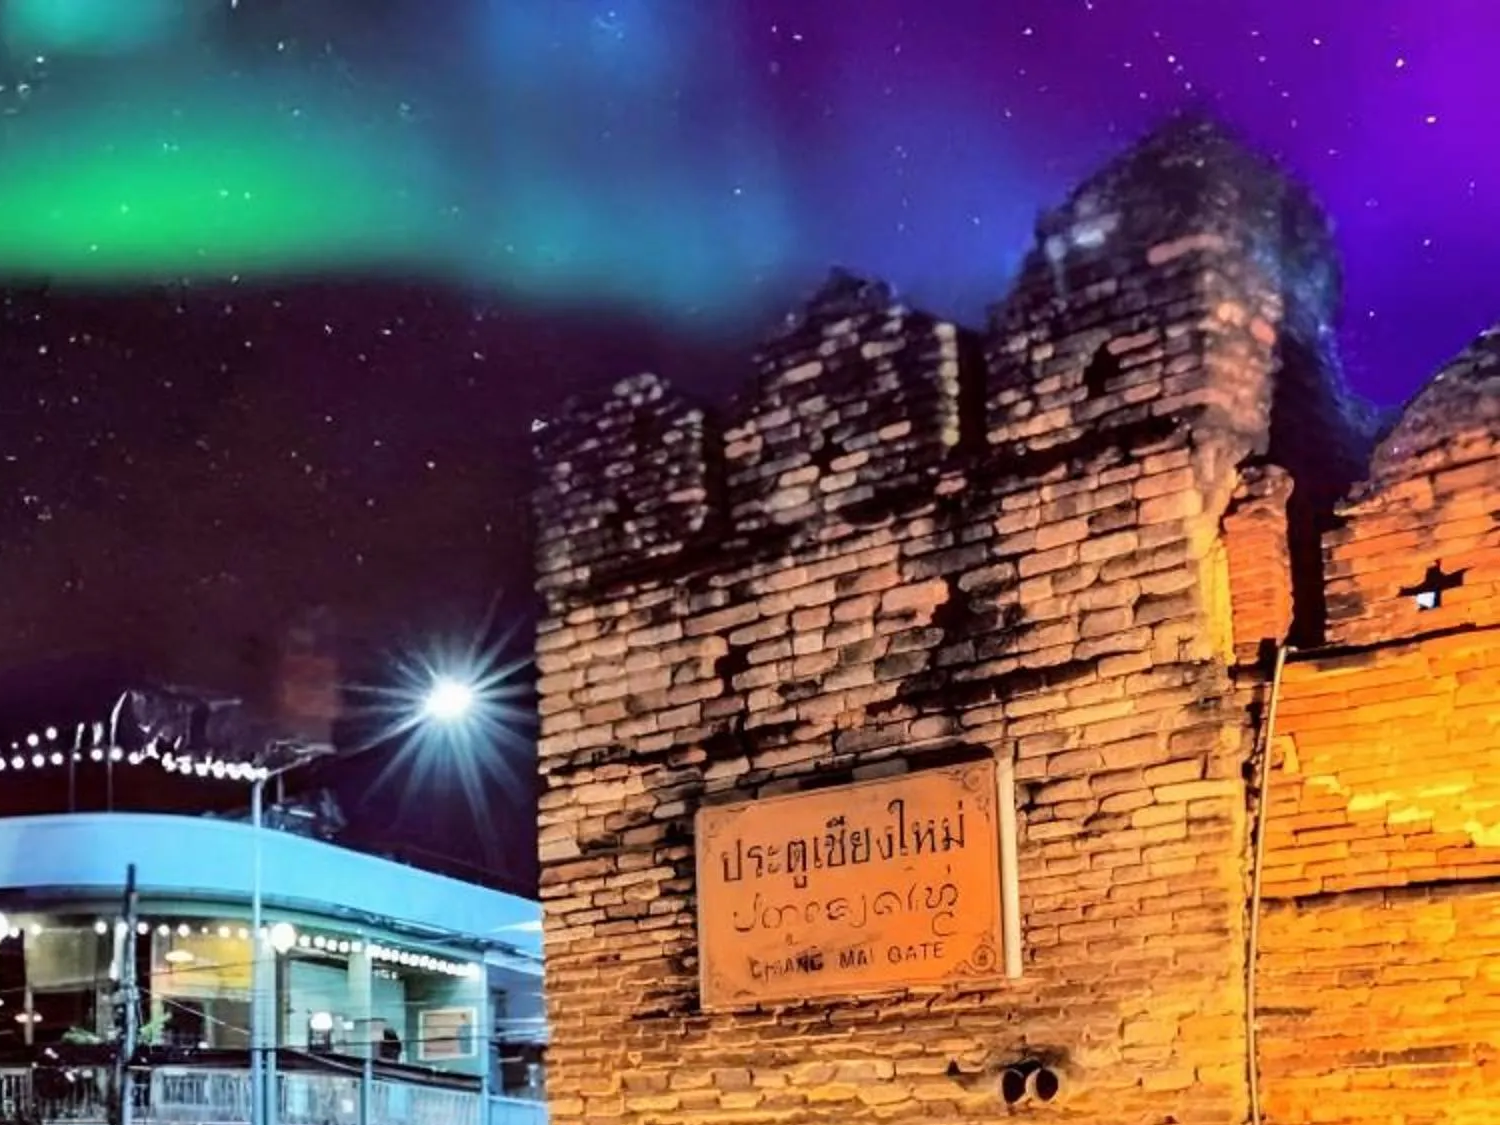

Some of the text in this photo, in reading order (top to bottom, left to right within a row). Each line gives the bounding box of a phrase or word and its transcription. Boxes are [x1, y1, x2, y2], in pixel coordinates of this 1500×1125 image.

[721, 799, 965, 888] ประตูเชียงใหม่
[887, 941, 945, 964] GATE
